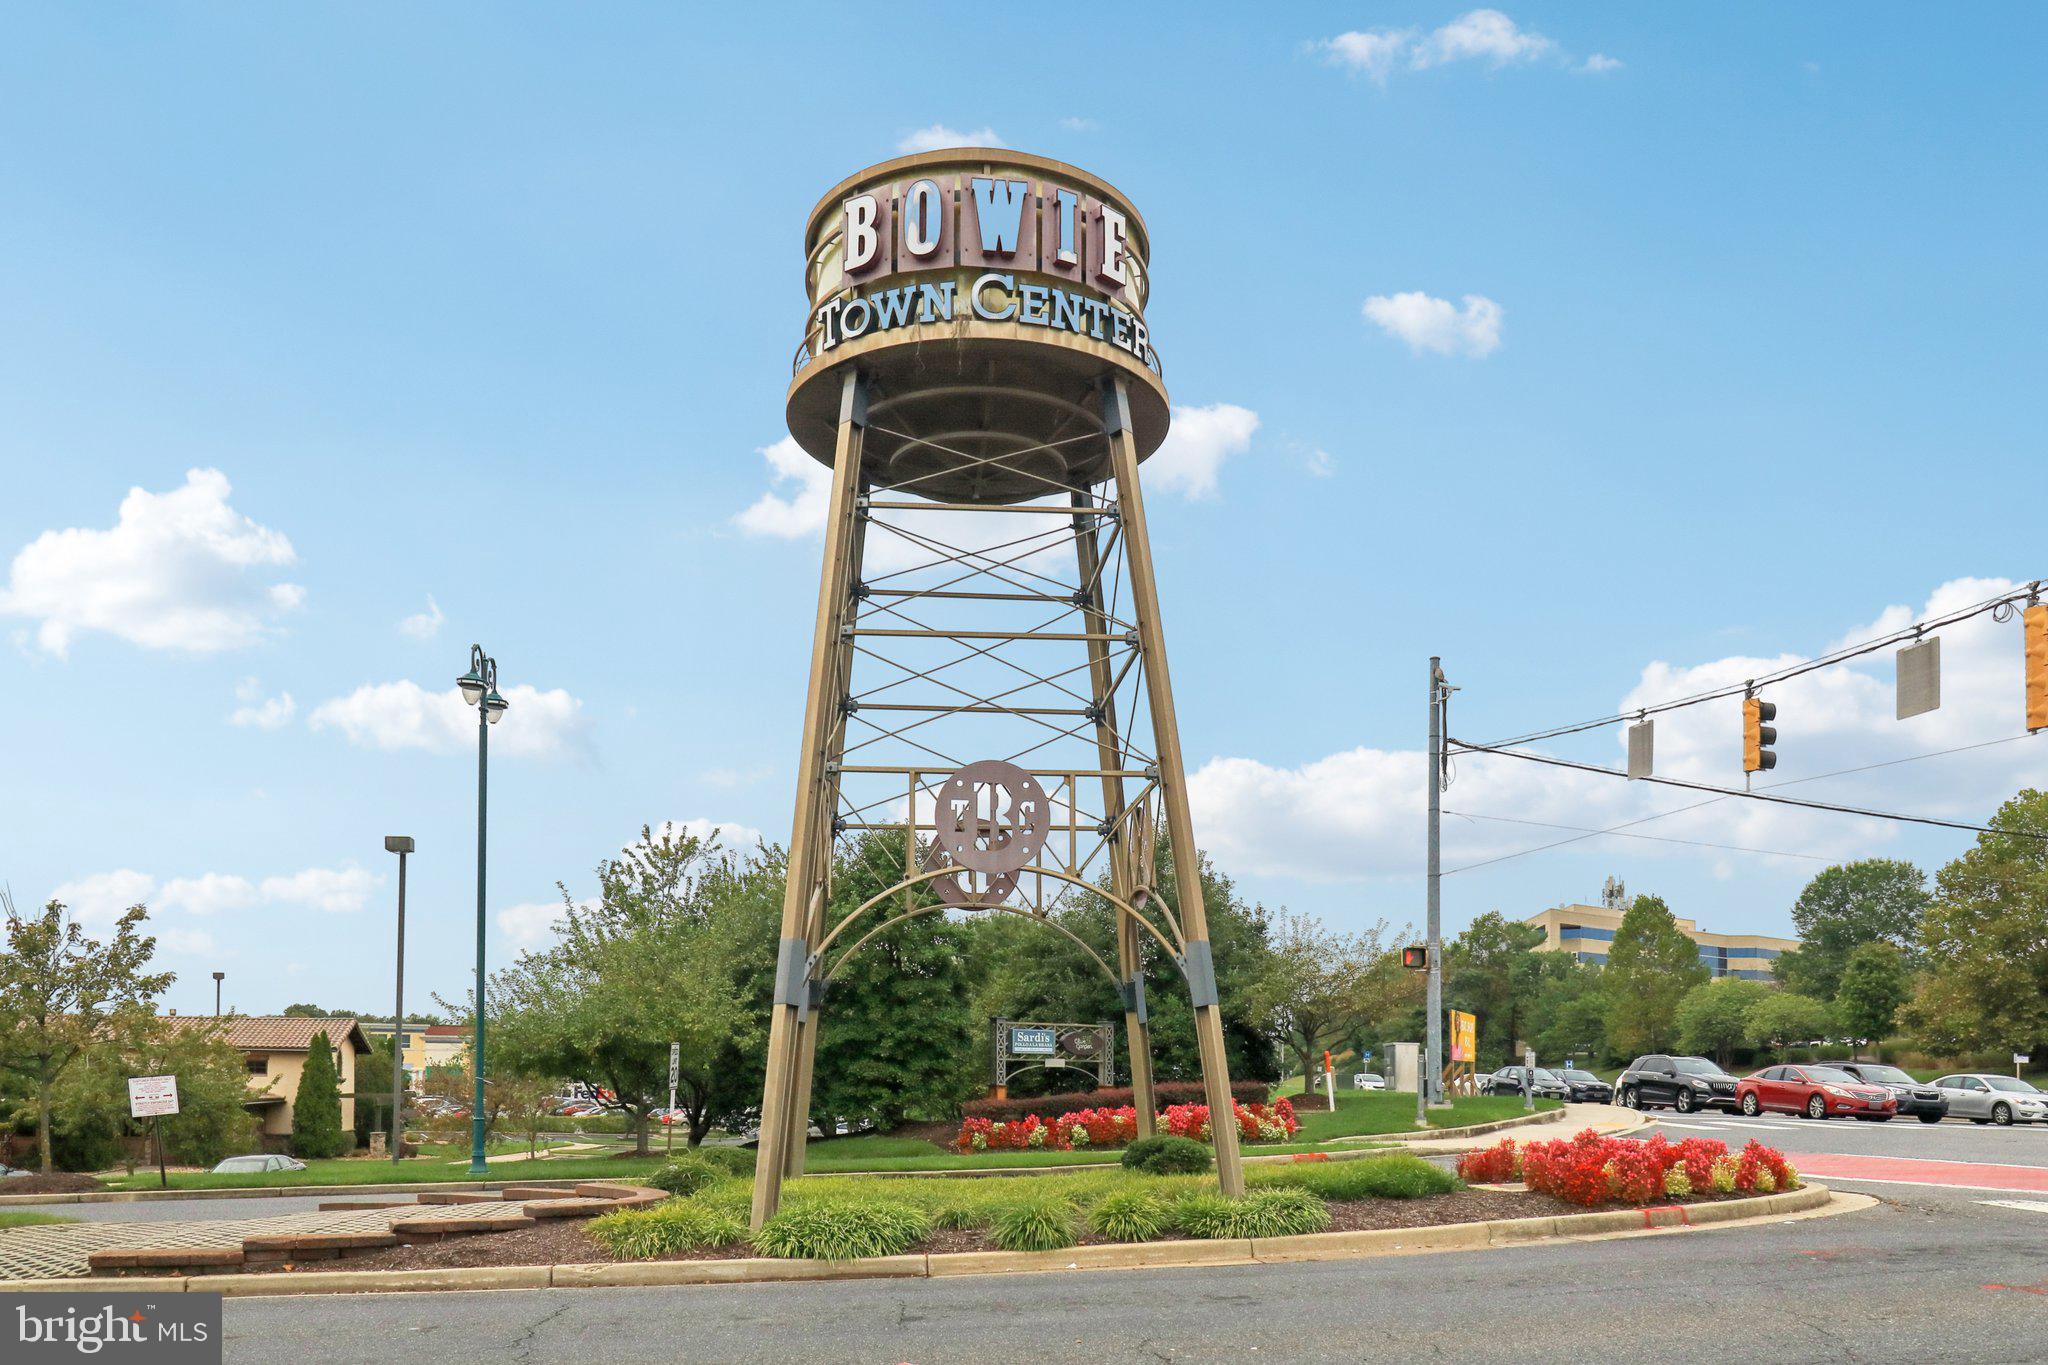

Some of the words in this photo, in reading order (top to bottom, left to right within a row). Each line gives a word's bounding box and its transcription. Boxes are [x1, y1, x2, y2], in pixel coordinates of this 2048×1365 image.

[843, 177, 1127, 286] BOWIE
[818, 280, 957, 351] TOWN
[970, 273, 1152, 366] CENTER
[1017, 1031, 1050, 1042] Sardi's
